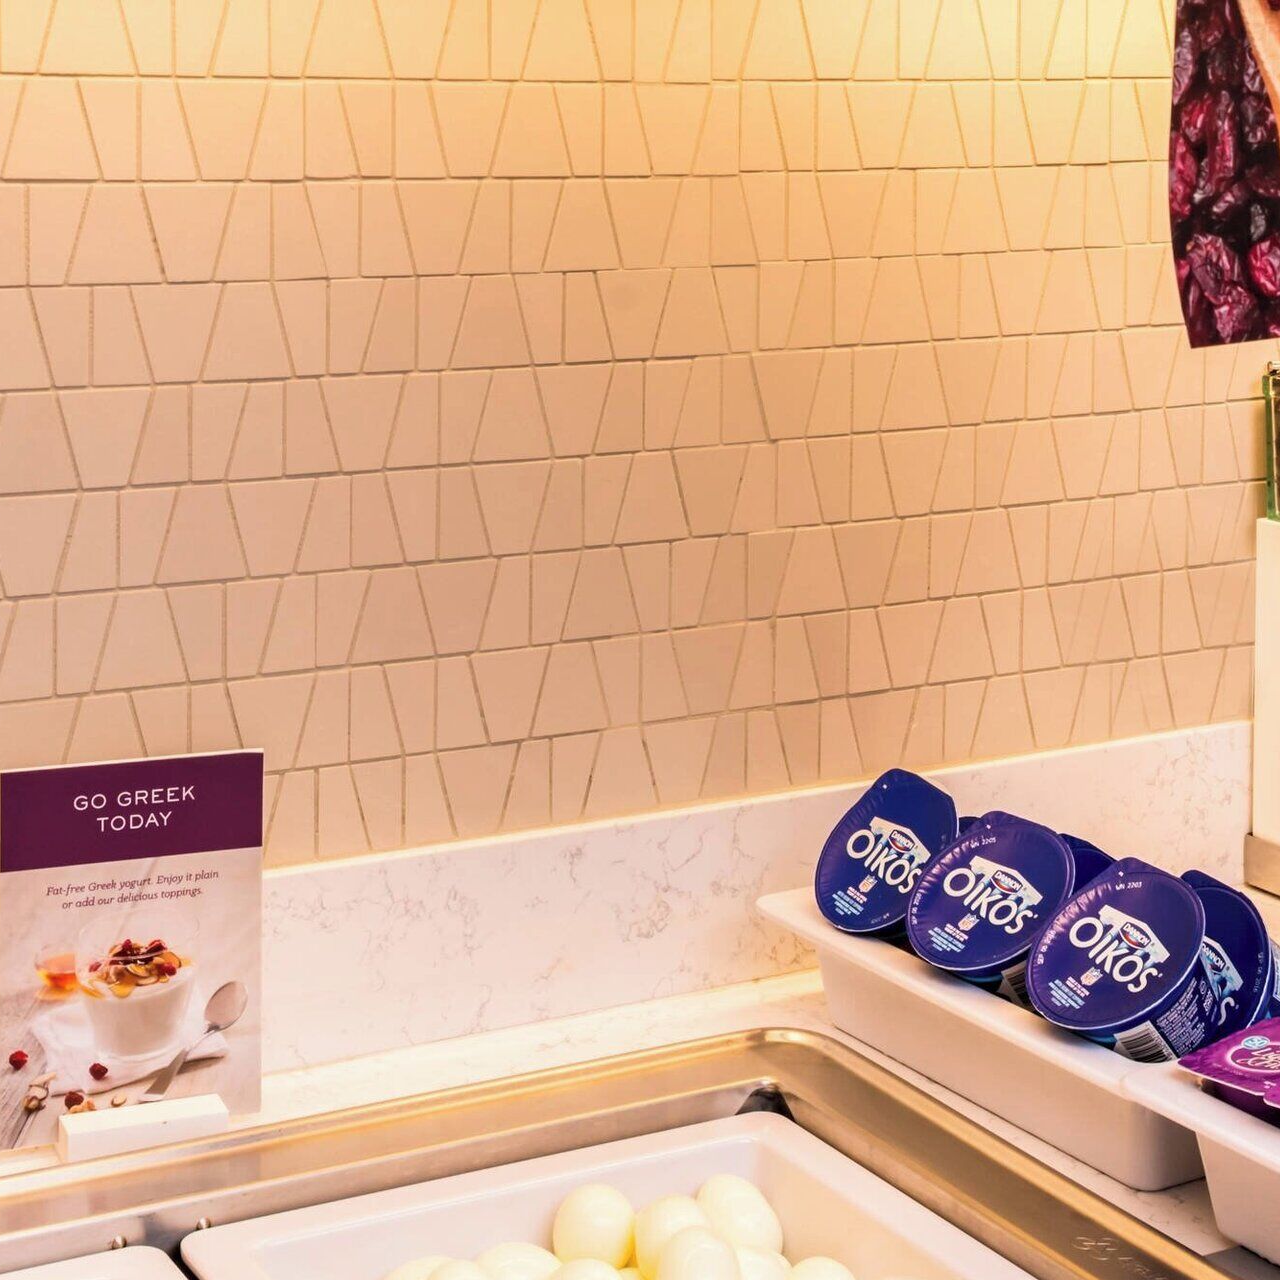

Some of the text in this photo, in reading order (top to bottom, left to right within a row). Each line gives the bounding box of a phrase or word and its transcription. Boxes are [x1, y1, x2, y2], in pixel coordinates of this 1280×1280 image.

[73, 785, 195, 811] GO GREEK
[96, 811, 172, 832] TODAY
[846, 829, 922, 894] OIKOS
[46, 884, 85, 896] Fat-free
[88, 879, 117, 892] Greek
[156, 874, 183, 885] Enjoy
[186, 872, 193, 881] it
[194, 870, 219, 883] plain
[994, 870, 1023, 891] DANNON
[62, 900, 73, 909] or
[75, 896, 95, 908] add
[97, 896, 115, 906] our
[117, 891, 158, 904] delicious
[943, 867, 1033, 935] OIKOS
[1122, 922, 1151, 948] DANNON
[1069, 916, 1158, 993] OIKOS
